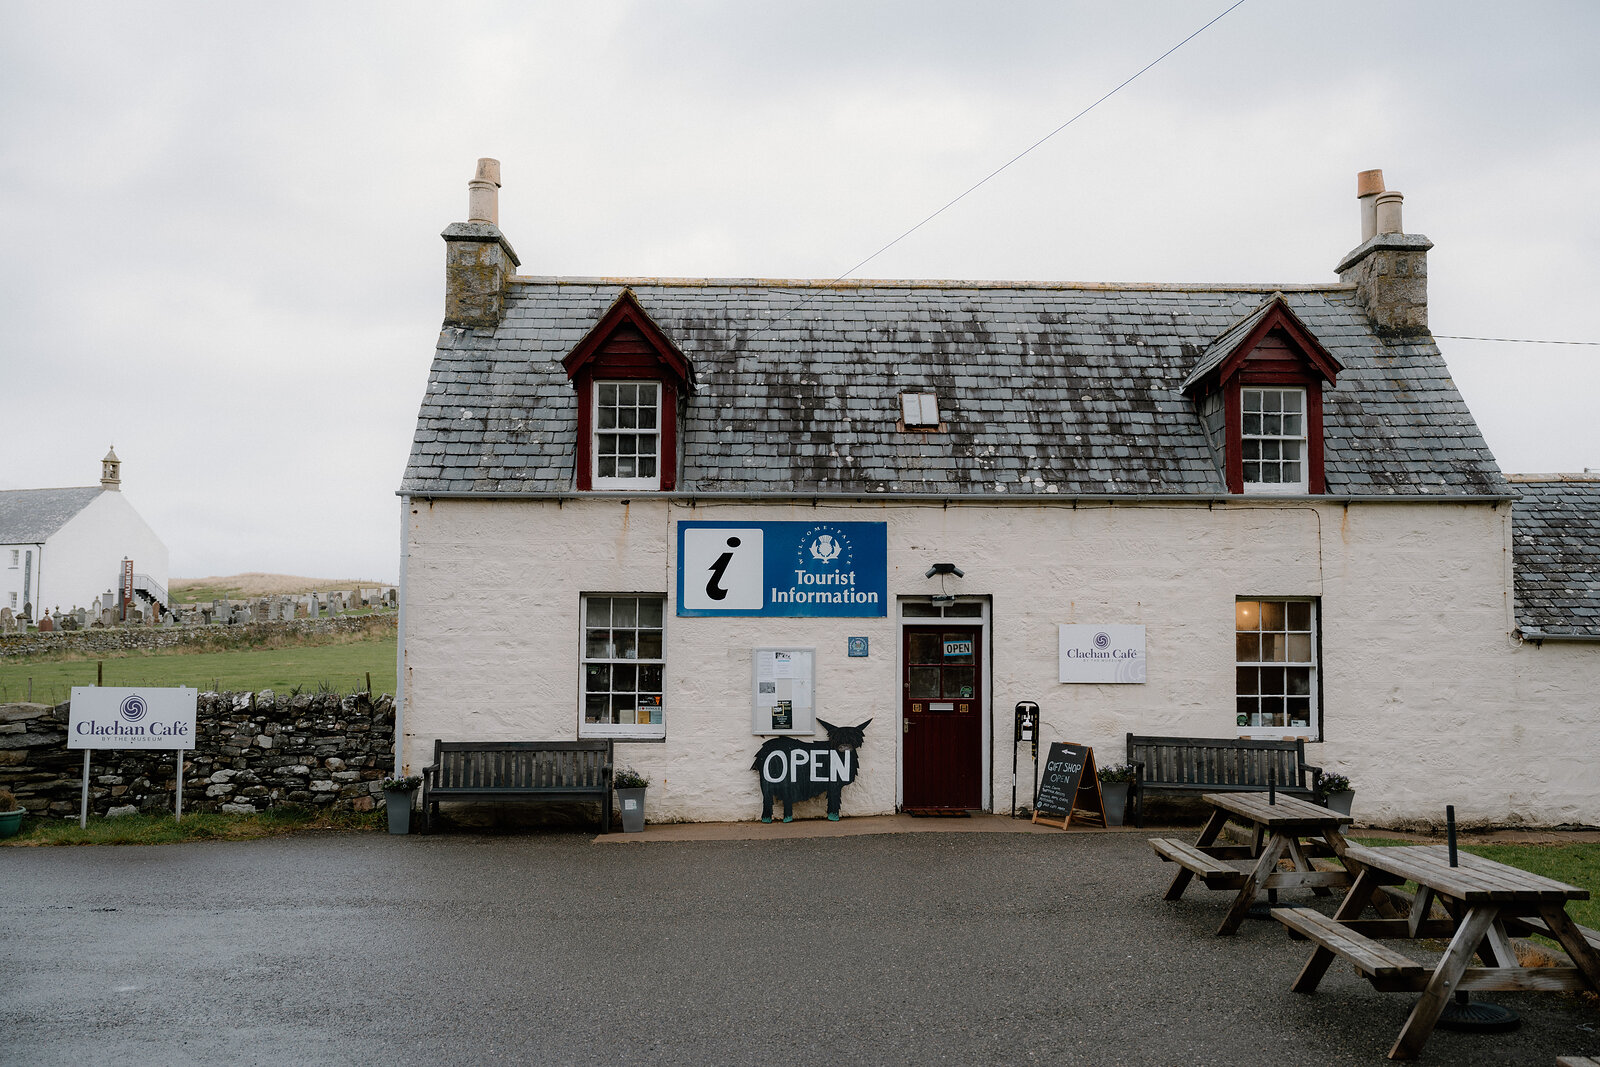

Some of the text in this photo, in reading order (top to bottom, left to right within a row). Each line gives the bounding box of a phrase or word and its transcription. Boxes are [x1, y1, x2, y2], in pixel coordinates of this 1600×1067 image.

[798, 525, 827, 565] WELCOME
[124, 561, 132, 599] MUSEUM
[794, 569, 856, 585] Tourist
[771, 587, 878, 604] Information
[946, 643, 970, 654] OPEN
[1066, 648, 1137, 659] Clachan Café
[76, 720, 188, 736] Clachan Café
[763, 748, 851, 784] OPEN
[1047, 760, 1082, 774] GIFT SHOP
[1050, 773, 1070, 784] OPEN
